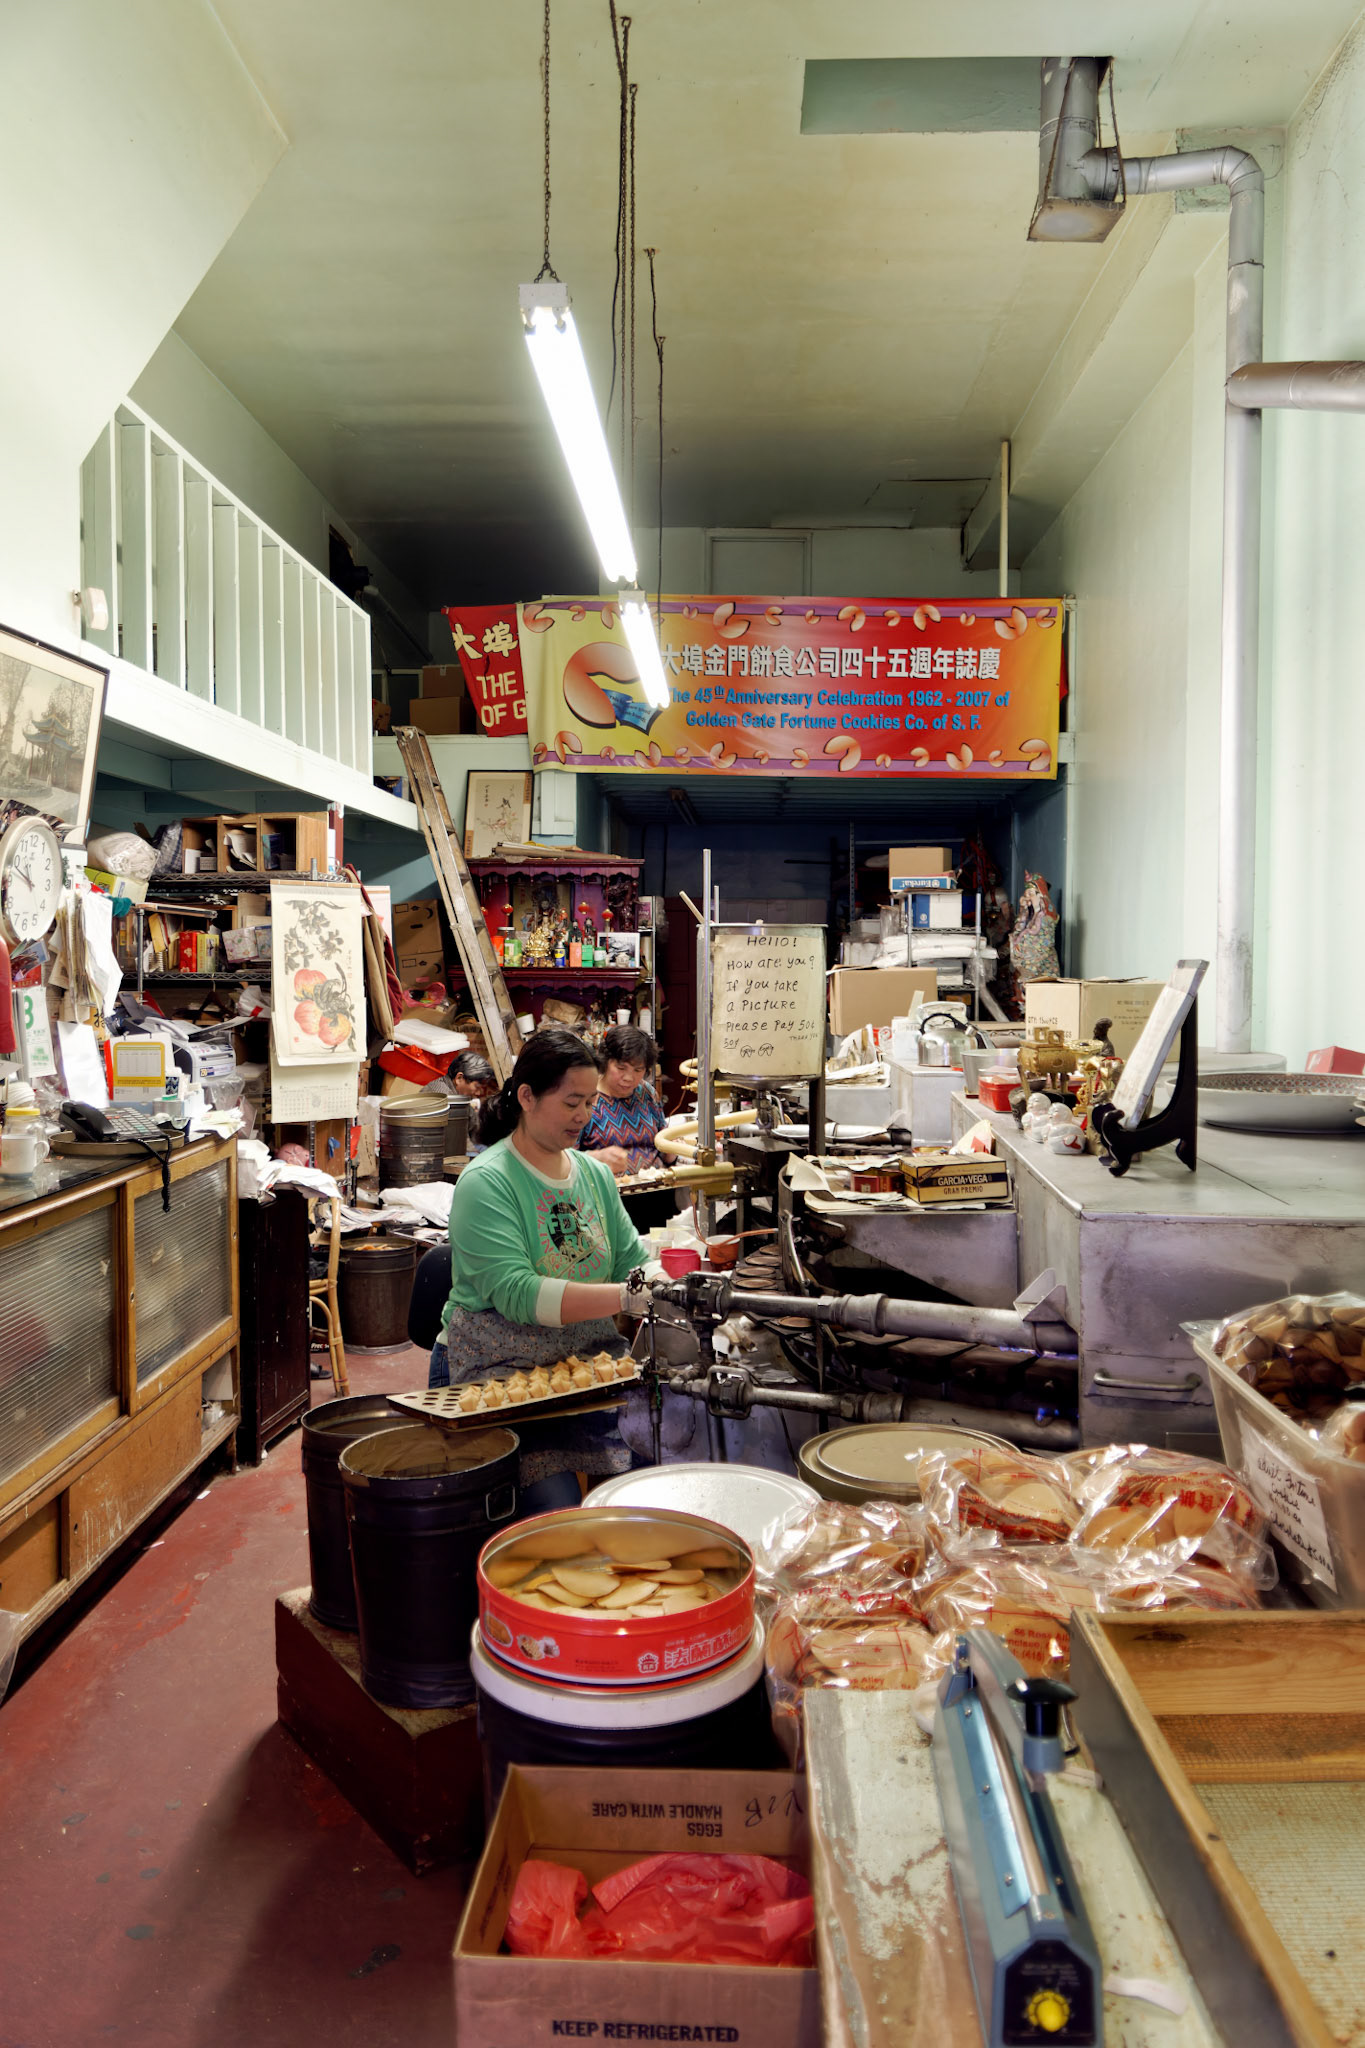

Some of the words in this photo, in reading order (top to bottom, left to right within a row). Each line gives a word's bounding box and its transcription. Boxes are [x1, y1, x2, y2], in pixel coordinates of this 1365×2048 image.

[476, 671, 518, 699] THE
[669, 687, 691, 703] he
[726, 687, 814, 709] Anniversary
[817, 689, 903, 706] Celebration
[907, 690, 943, 707] 1962
[955, 691, 991, 707] 2007
[995, 690, 1011, 707] of
[481, 704, 507, 728] OF
[686, 710, 738, 728] Golden
[742, 711, 777, 728] Gate
[780, 712, 837, 729] Fortune
[842, 713, 900, 730] Cookies
[905, 713, 928, 730] Co.
[932, 714, 948, 730] of
[952, 714, 966, 730] S.
[970, 714, 982, 730] F.
[726, 980, 739, 992] If
[744, 979, 769, 994] you
[774, 980, 799, 992] take
[937, 1176, 965, 1186] GARCIA
[967, 1174, 988, 1184] VEGA
[961, 1186, 983, 1194] PREMIO
[592, 1802, 628, 1817] CARE
[630, 1804, 665, 1818] WITH
[669, 1804, 723, 1819] HANDLE
[687, 1822, 723, 1837] EGGS
[552, 2020, 599, 2037] KEEP
[603, 2022, 740, 2043] REFRIGERATED
